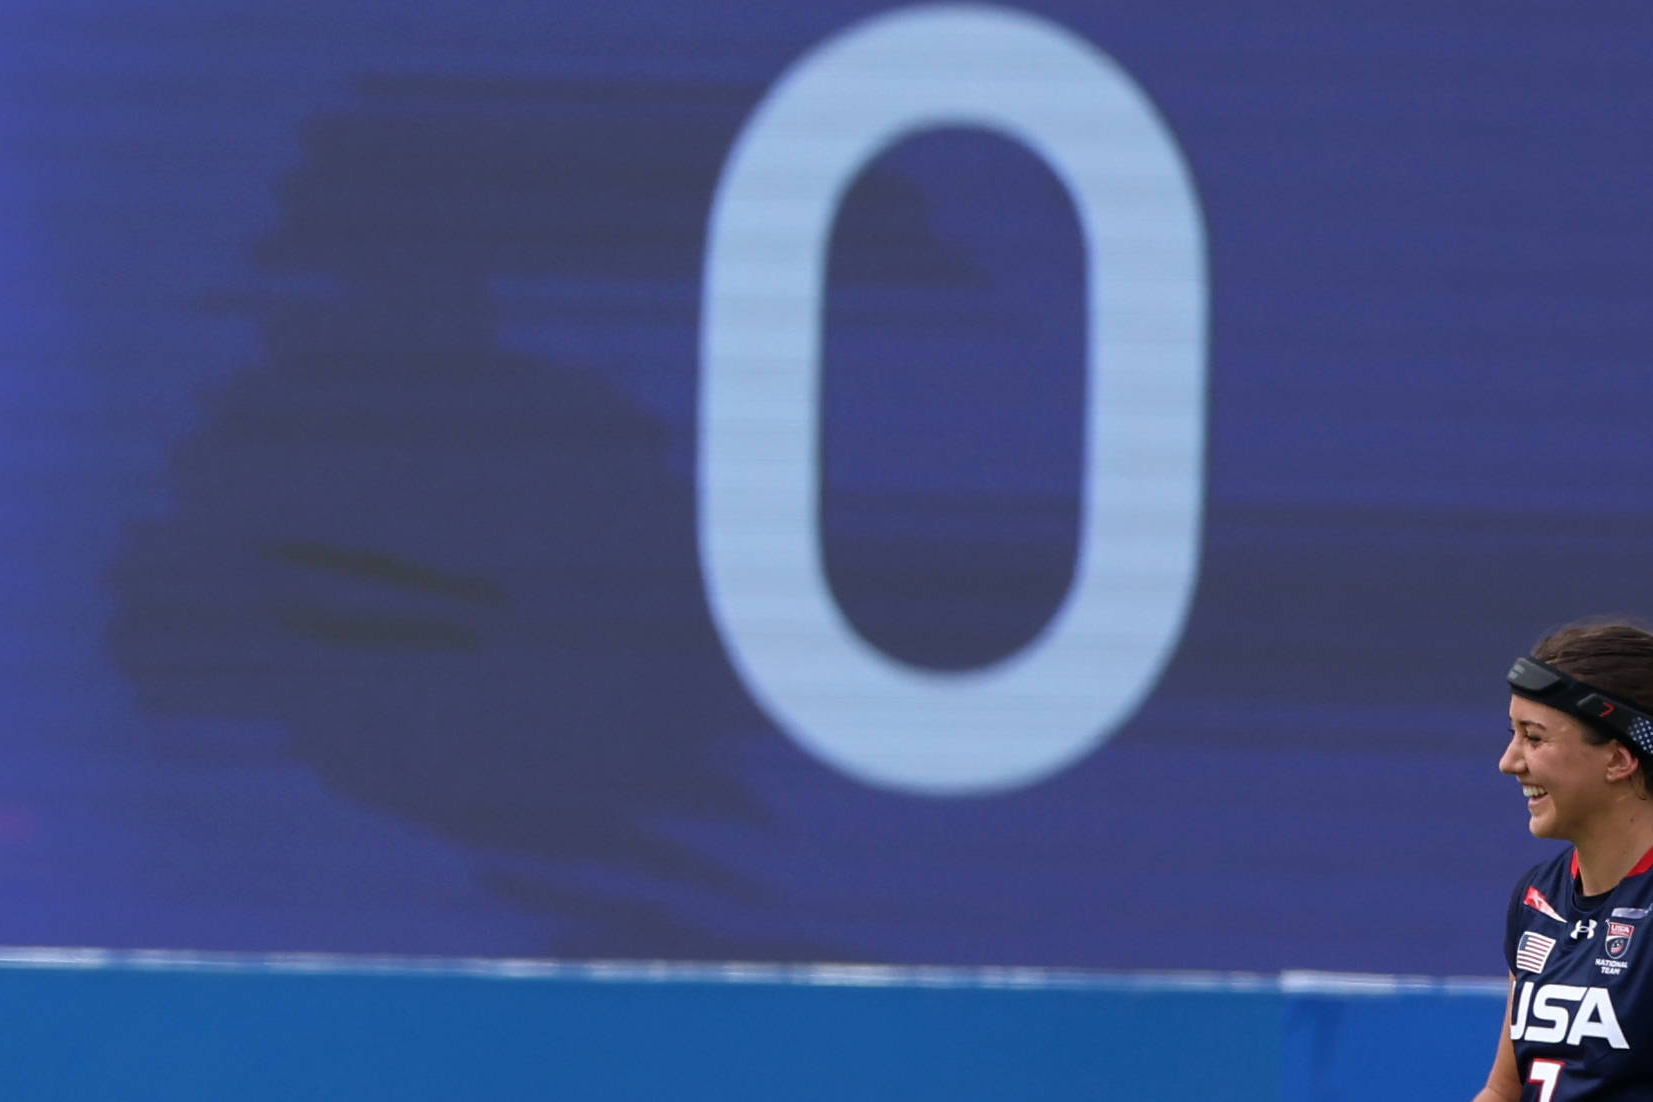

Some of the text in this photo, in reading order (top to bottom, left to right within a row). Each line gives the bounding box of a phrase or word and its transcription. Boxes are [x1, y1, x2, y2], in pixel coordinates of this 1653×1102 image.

[697, 3, 1210, 797] 0
[1595, 958, 1628, 969] NATIONAL
[1601, 966, 1621, 975] TEAM
[1510, 980, 1630, 1049] USA
